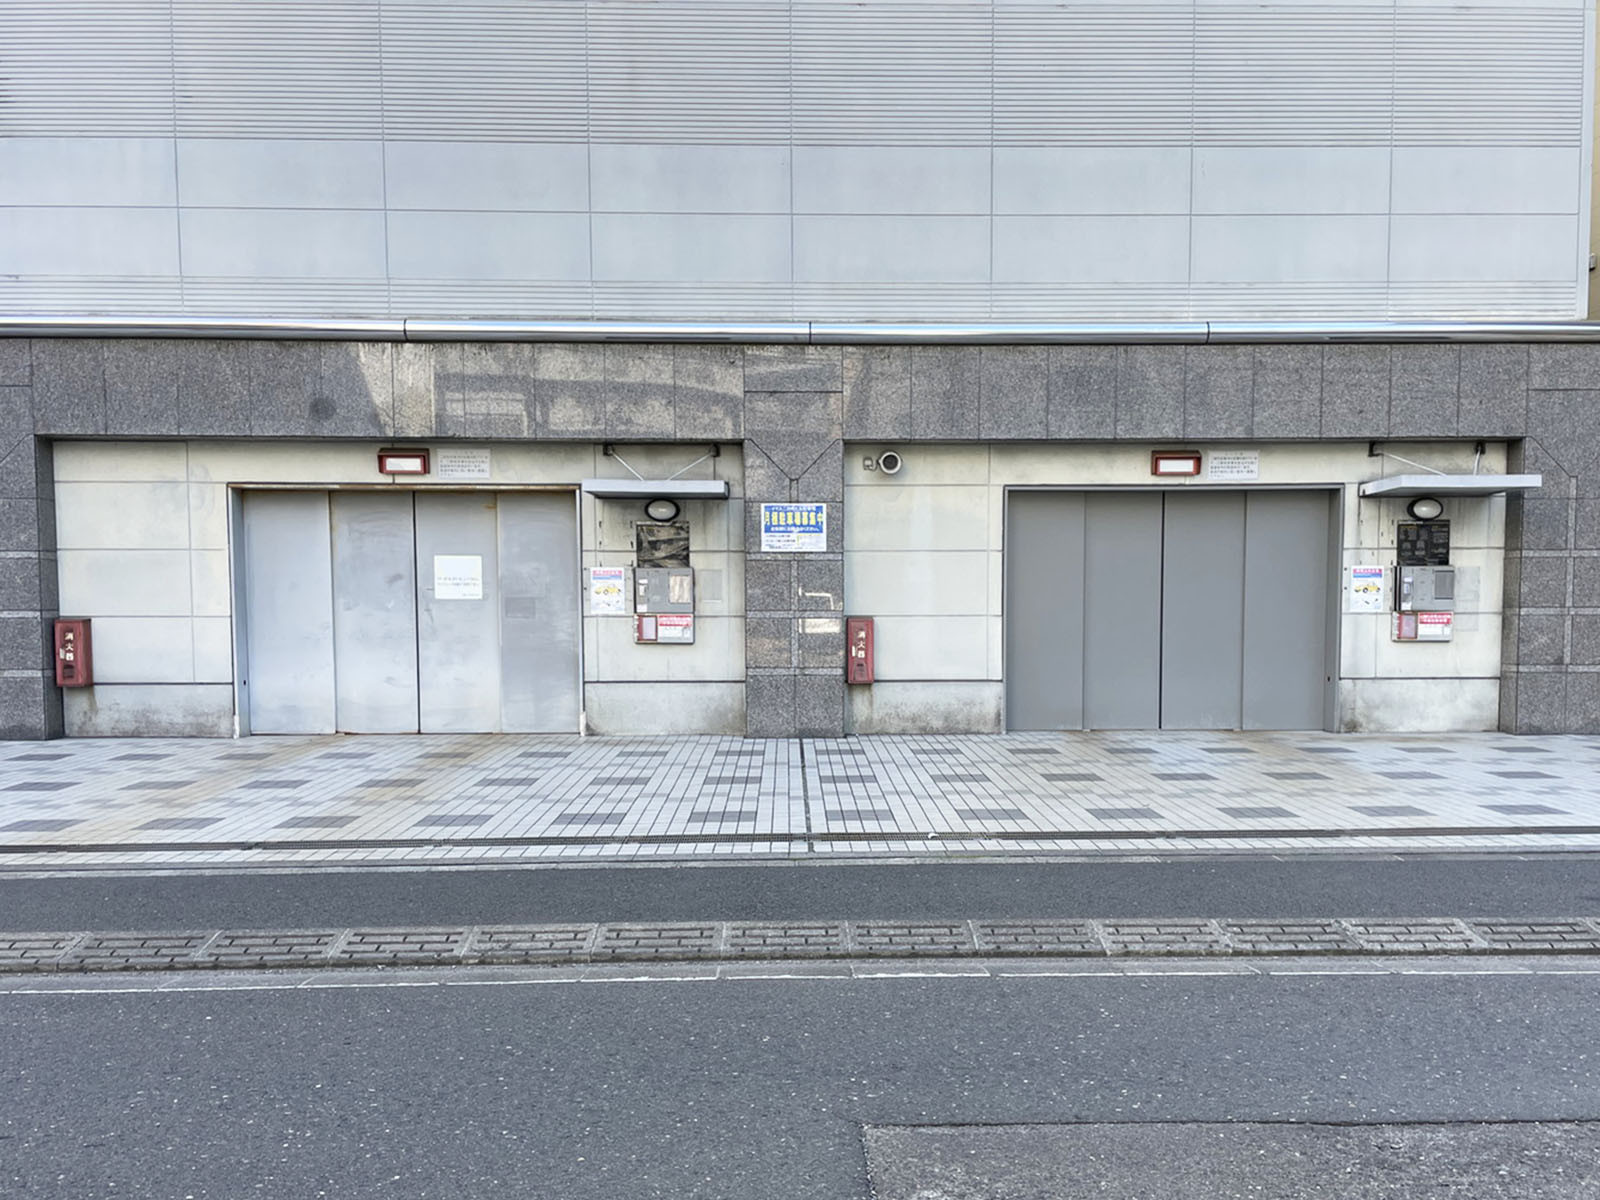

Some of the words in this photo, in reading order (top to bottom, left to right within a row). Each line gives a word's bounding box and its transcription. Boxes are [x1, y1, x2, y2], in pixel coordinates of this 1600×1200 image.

[64, 632, 74, 661] 消火器
[857, 631, 866, 658] 消火器
